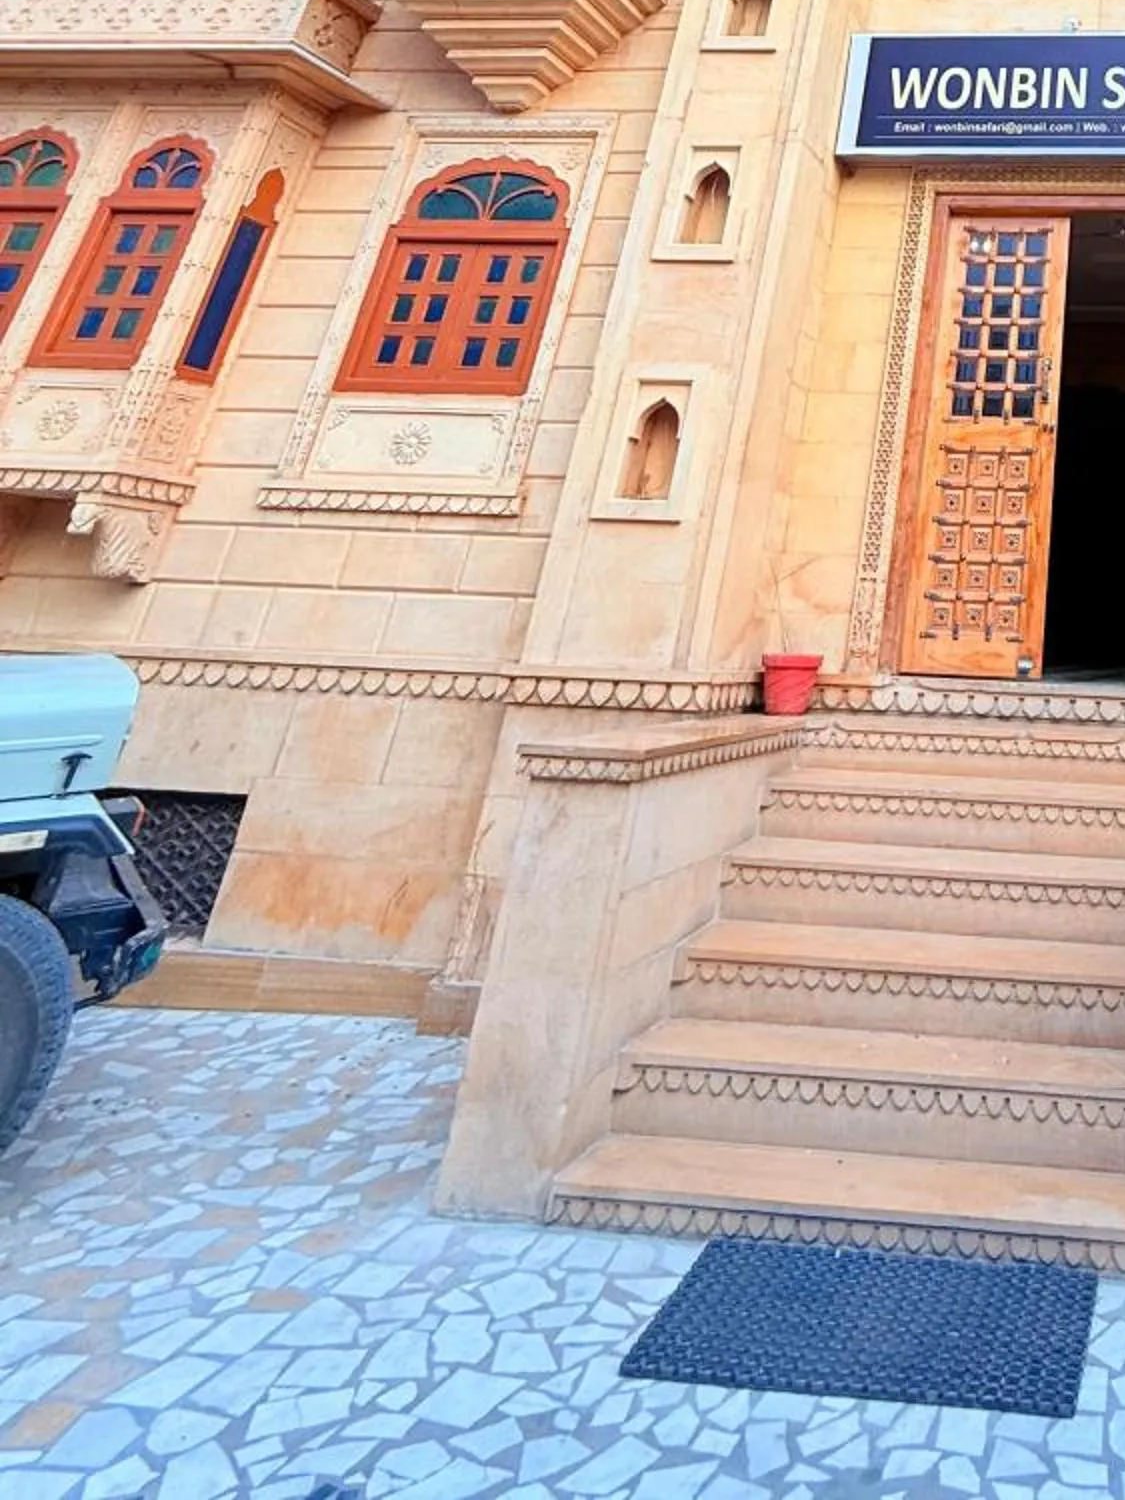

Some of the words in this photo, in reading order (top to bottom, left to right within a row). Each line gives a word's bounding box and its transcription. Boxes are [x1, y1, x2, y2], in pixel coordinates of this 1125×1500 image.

[891, 67, 1088, 110] WONBIN
[894, 121, 925, 133] Email
[935, 122, 1073, 134] wonbinsafari@gmail.com
